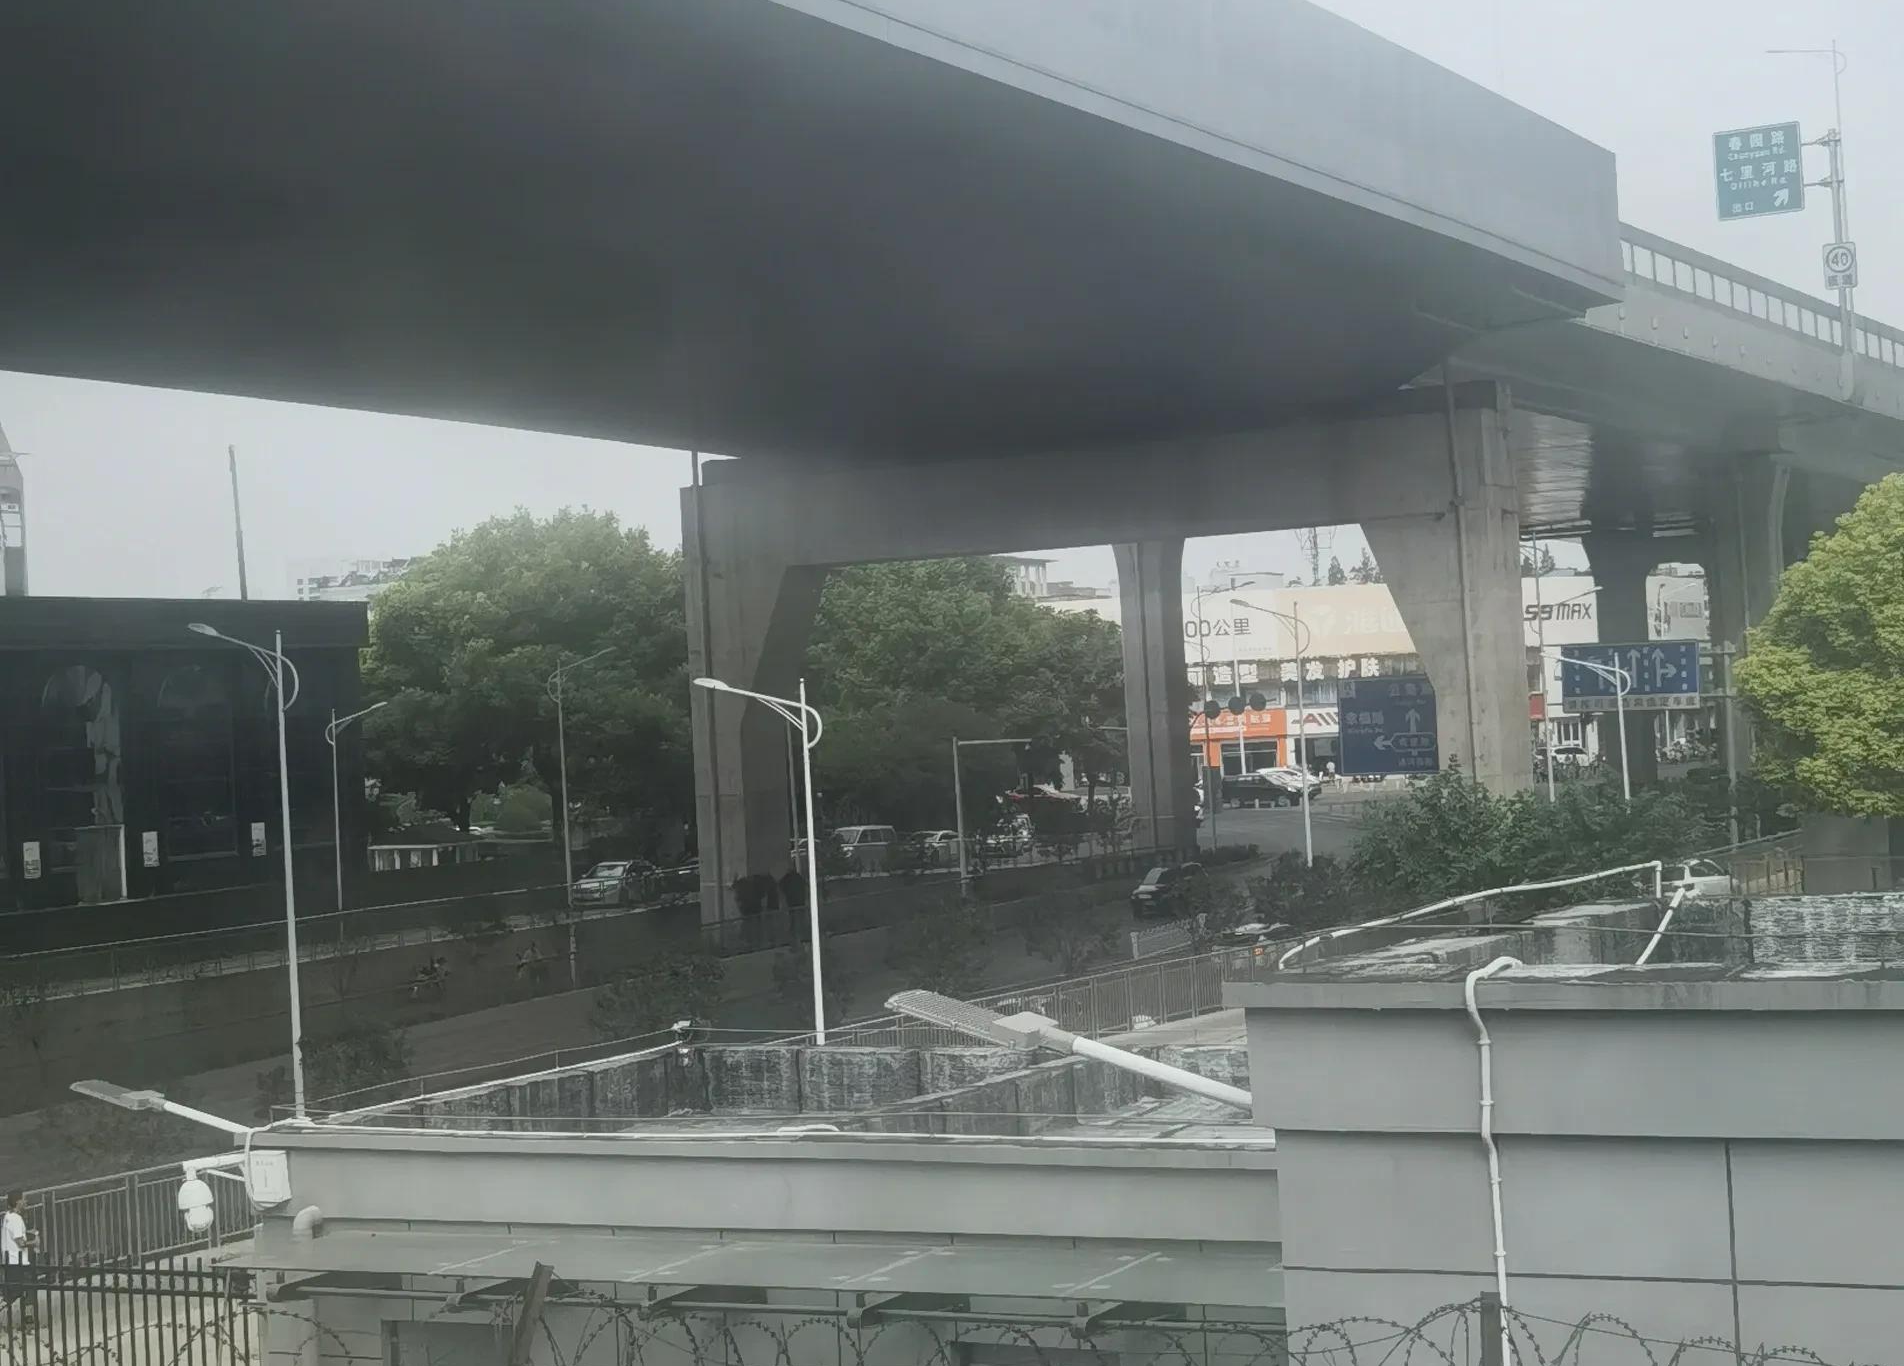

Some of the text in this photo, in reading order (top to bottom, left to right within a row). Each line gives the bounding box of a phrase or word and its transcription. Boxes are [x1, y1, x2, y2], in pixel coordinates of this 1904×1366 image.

[1720, 159, 1798, 182] 七里河路
[1831, 251, 1849, 267] 40
